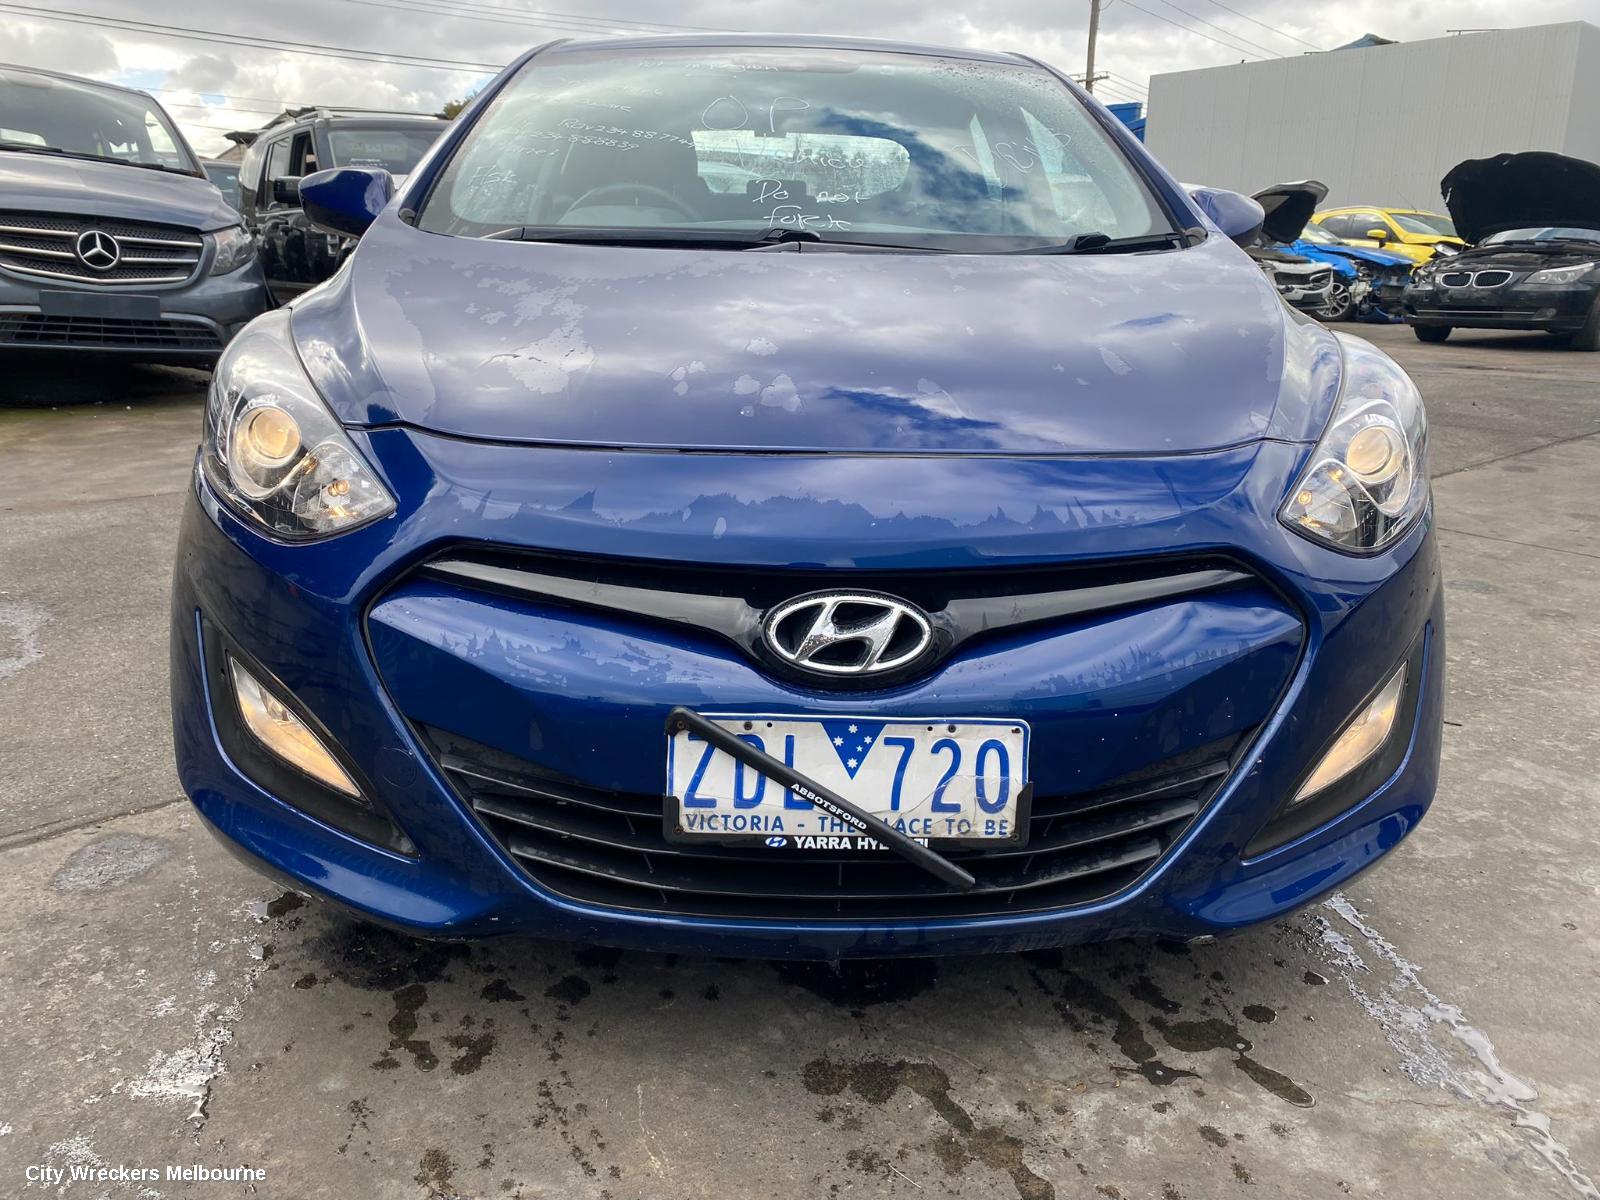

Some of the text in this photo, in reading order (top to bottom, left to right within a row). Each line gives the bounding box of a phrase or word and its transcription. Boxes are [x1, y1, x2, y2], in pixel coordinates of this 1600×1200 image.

[883, 736, 1010, 814] 720
[791, 783, 867, 830] ABBOTSFORD
[686, 813, 784, 832] VICTORIA
[945, 818, 971, 835] TO
[984, 819, 1009, 836] BE
[794, 836, 852, 849] YARRA
